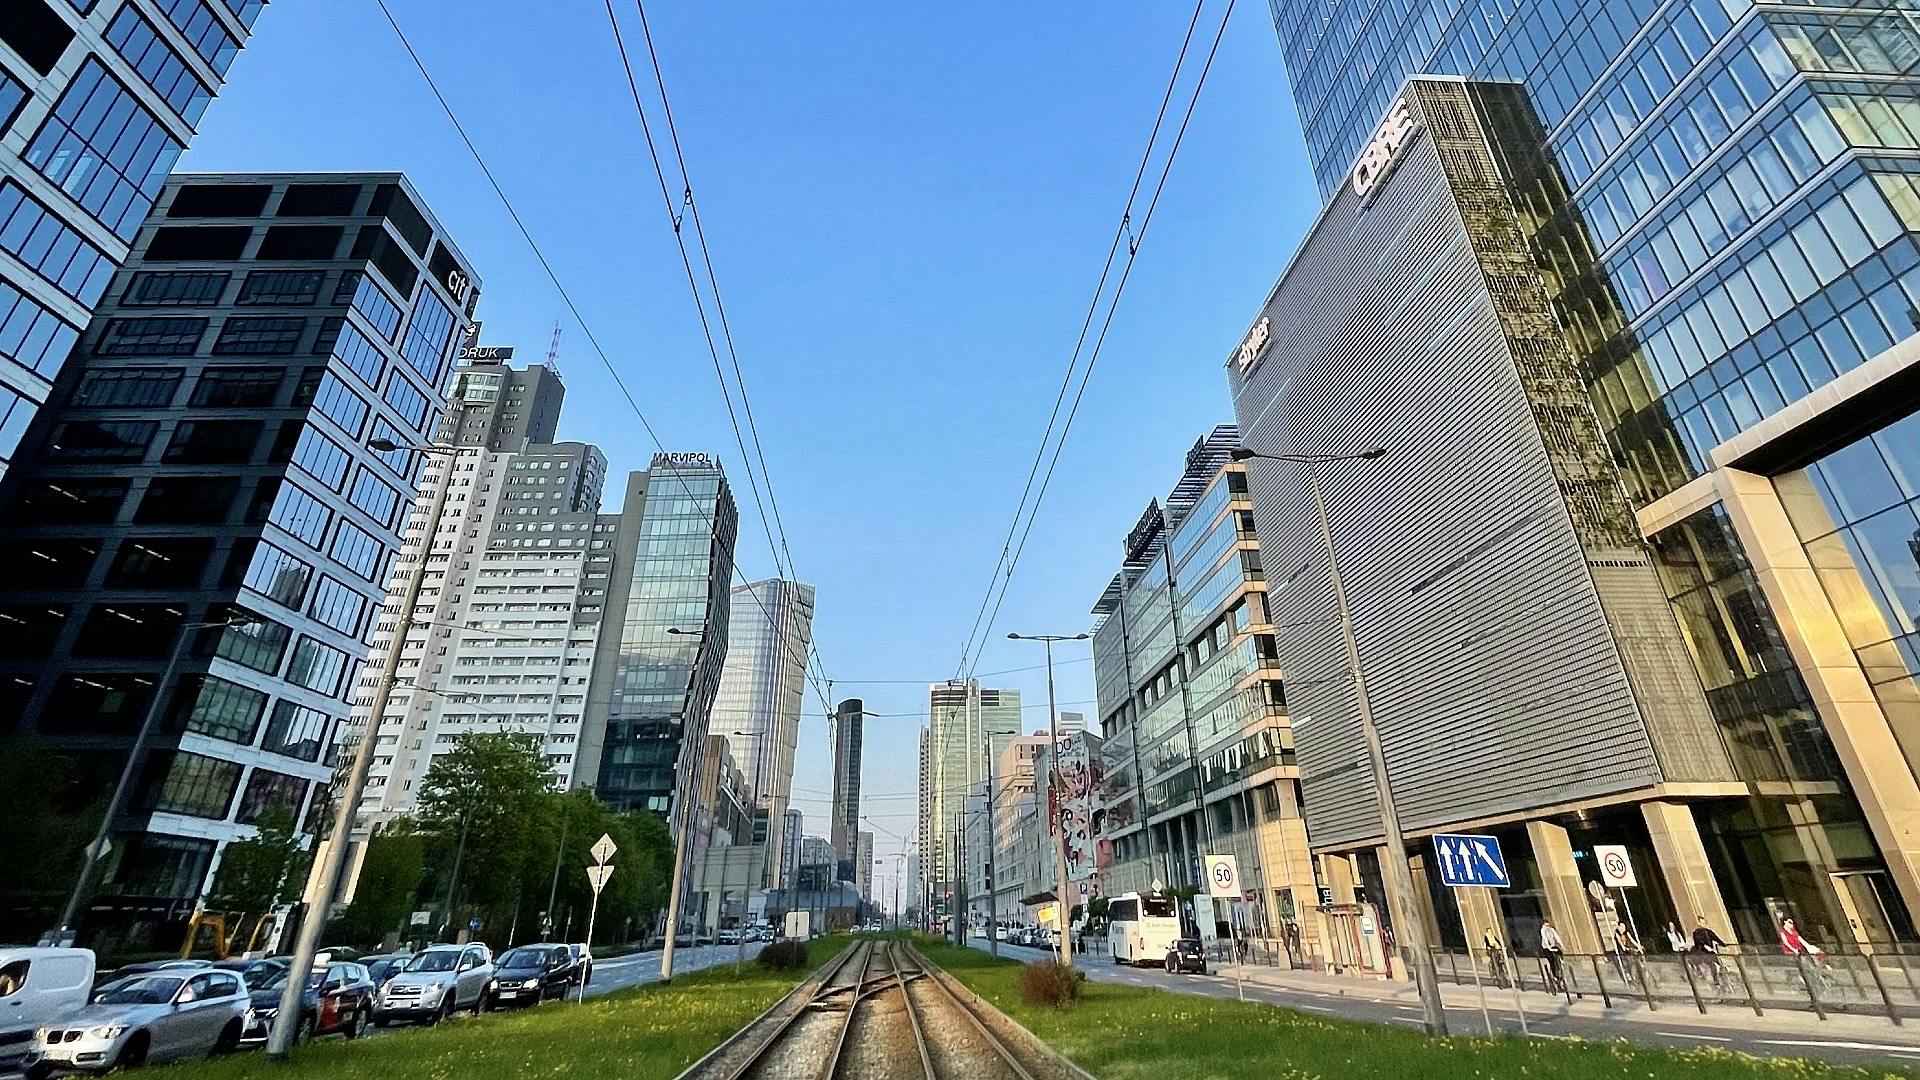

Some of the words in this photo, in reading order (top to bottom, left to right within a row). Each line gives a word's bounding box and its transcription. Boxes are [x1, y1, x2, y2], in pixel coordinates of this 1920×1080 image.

[1353, 98, 1414, 196] CBRE
[653, 453, 711, 463] MARVIPOL
[1608, 859, 1624, 872] 50
[1216, 869, 1231, 881] 50
